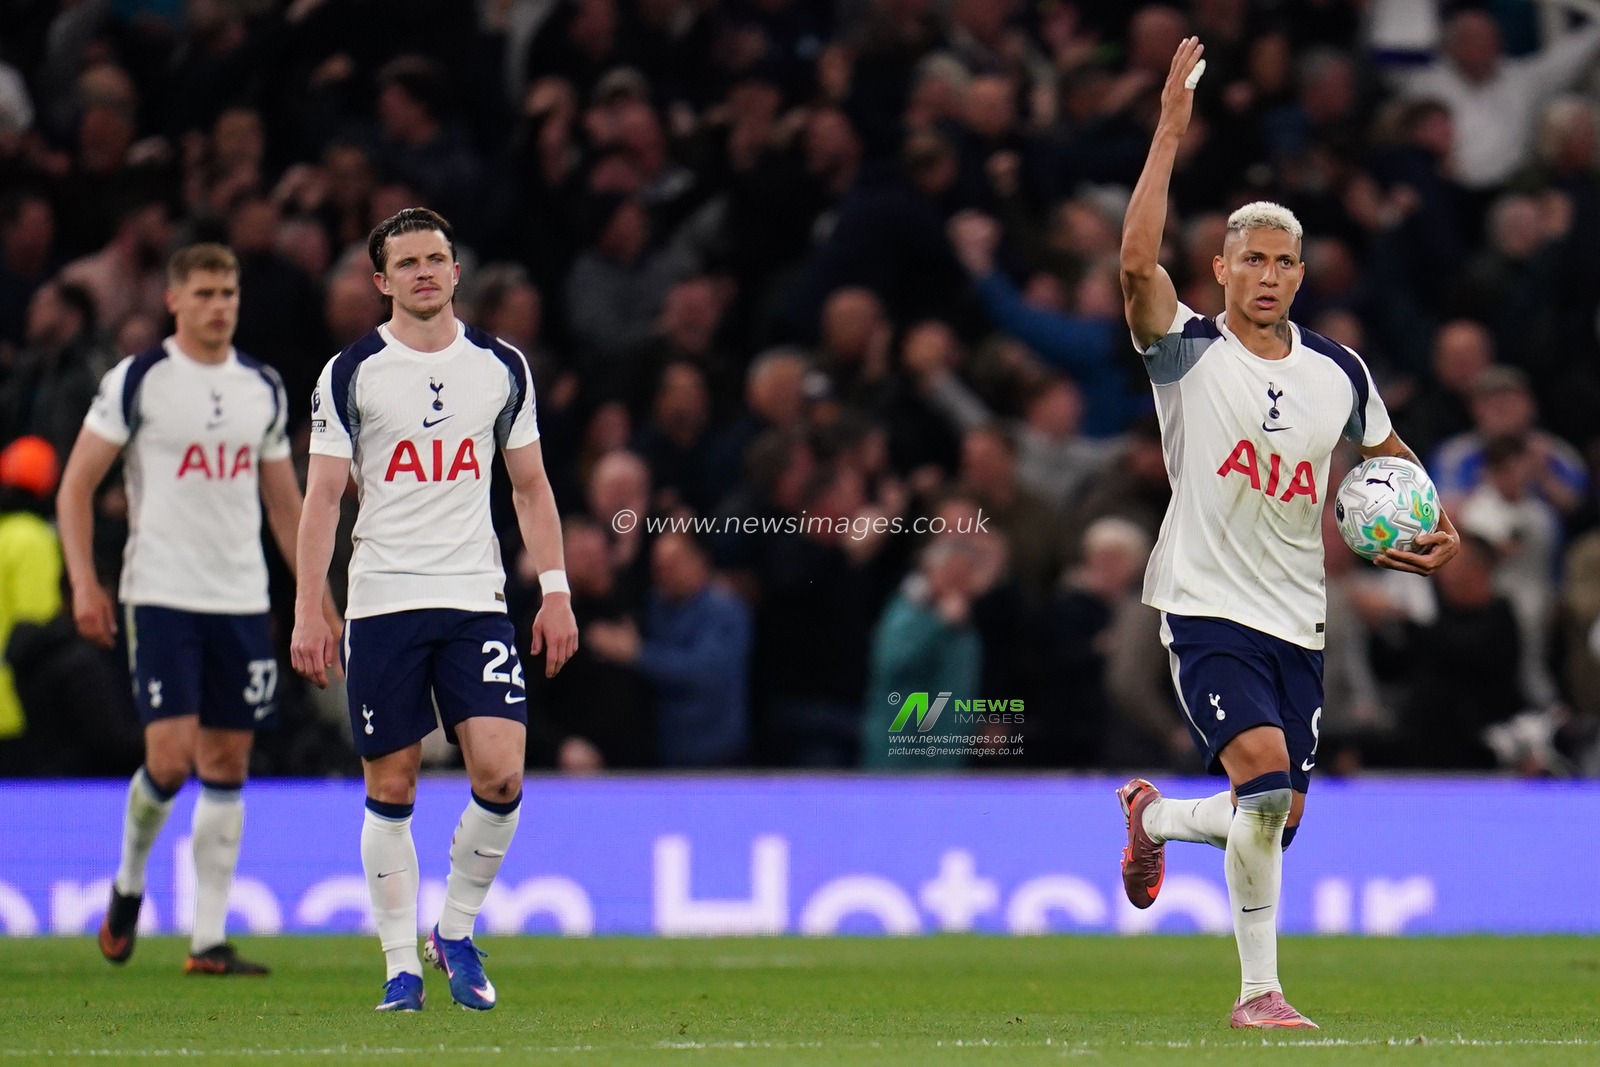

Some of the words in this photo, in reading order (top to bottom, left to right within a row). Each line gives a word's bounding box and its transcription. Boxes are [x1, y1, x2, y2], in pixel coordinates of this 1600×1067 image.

[176, 442, 254, 479] AIA
[384, 438, 480, 482] AIA
[1216, 439, 1318, 505] AIA
[243, 659, 278, 705] 37
